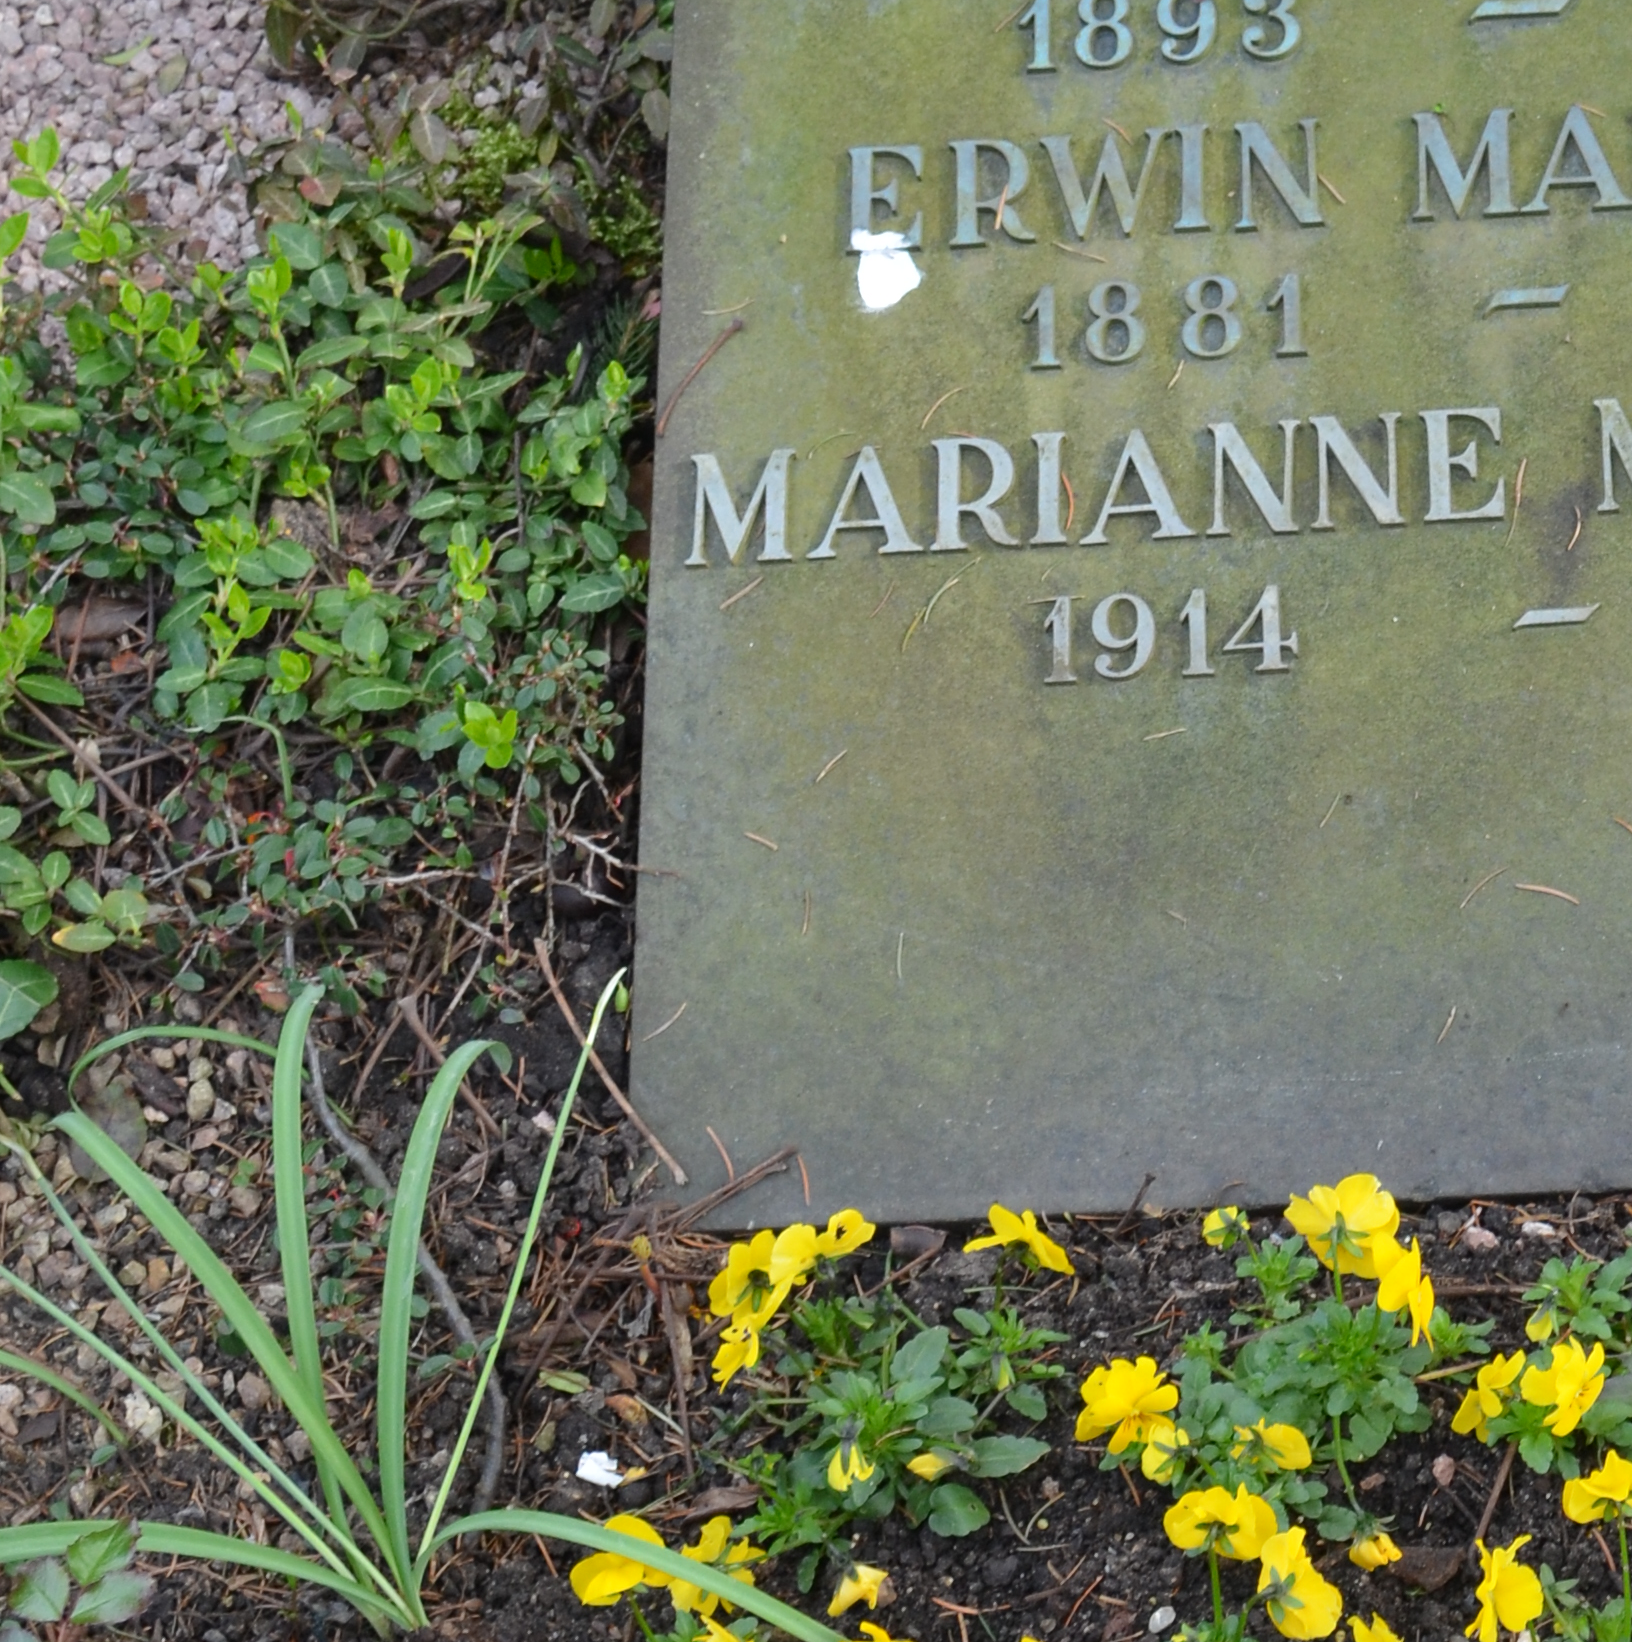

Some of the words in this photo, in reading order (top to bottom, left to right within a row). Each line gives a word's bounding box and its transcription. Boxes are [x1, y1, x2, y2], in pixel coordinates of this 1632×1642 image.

[847, 119, 1324, 255] ERWIN
[1023, 274, 1308, 369] 1881
[684, 407, 1505, 567] MARIANNE
[1044, 584, 1298, 684] 1914
